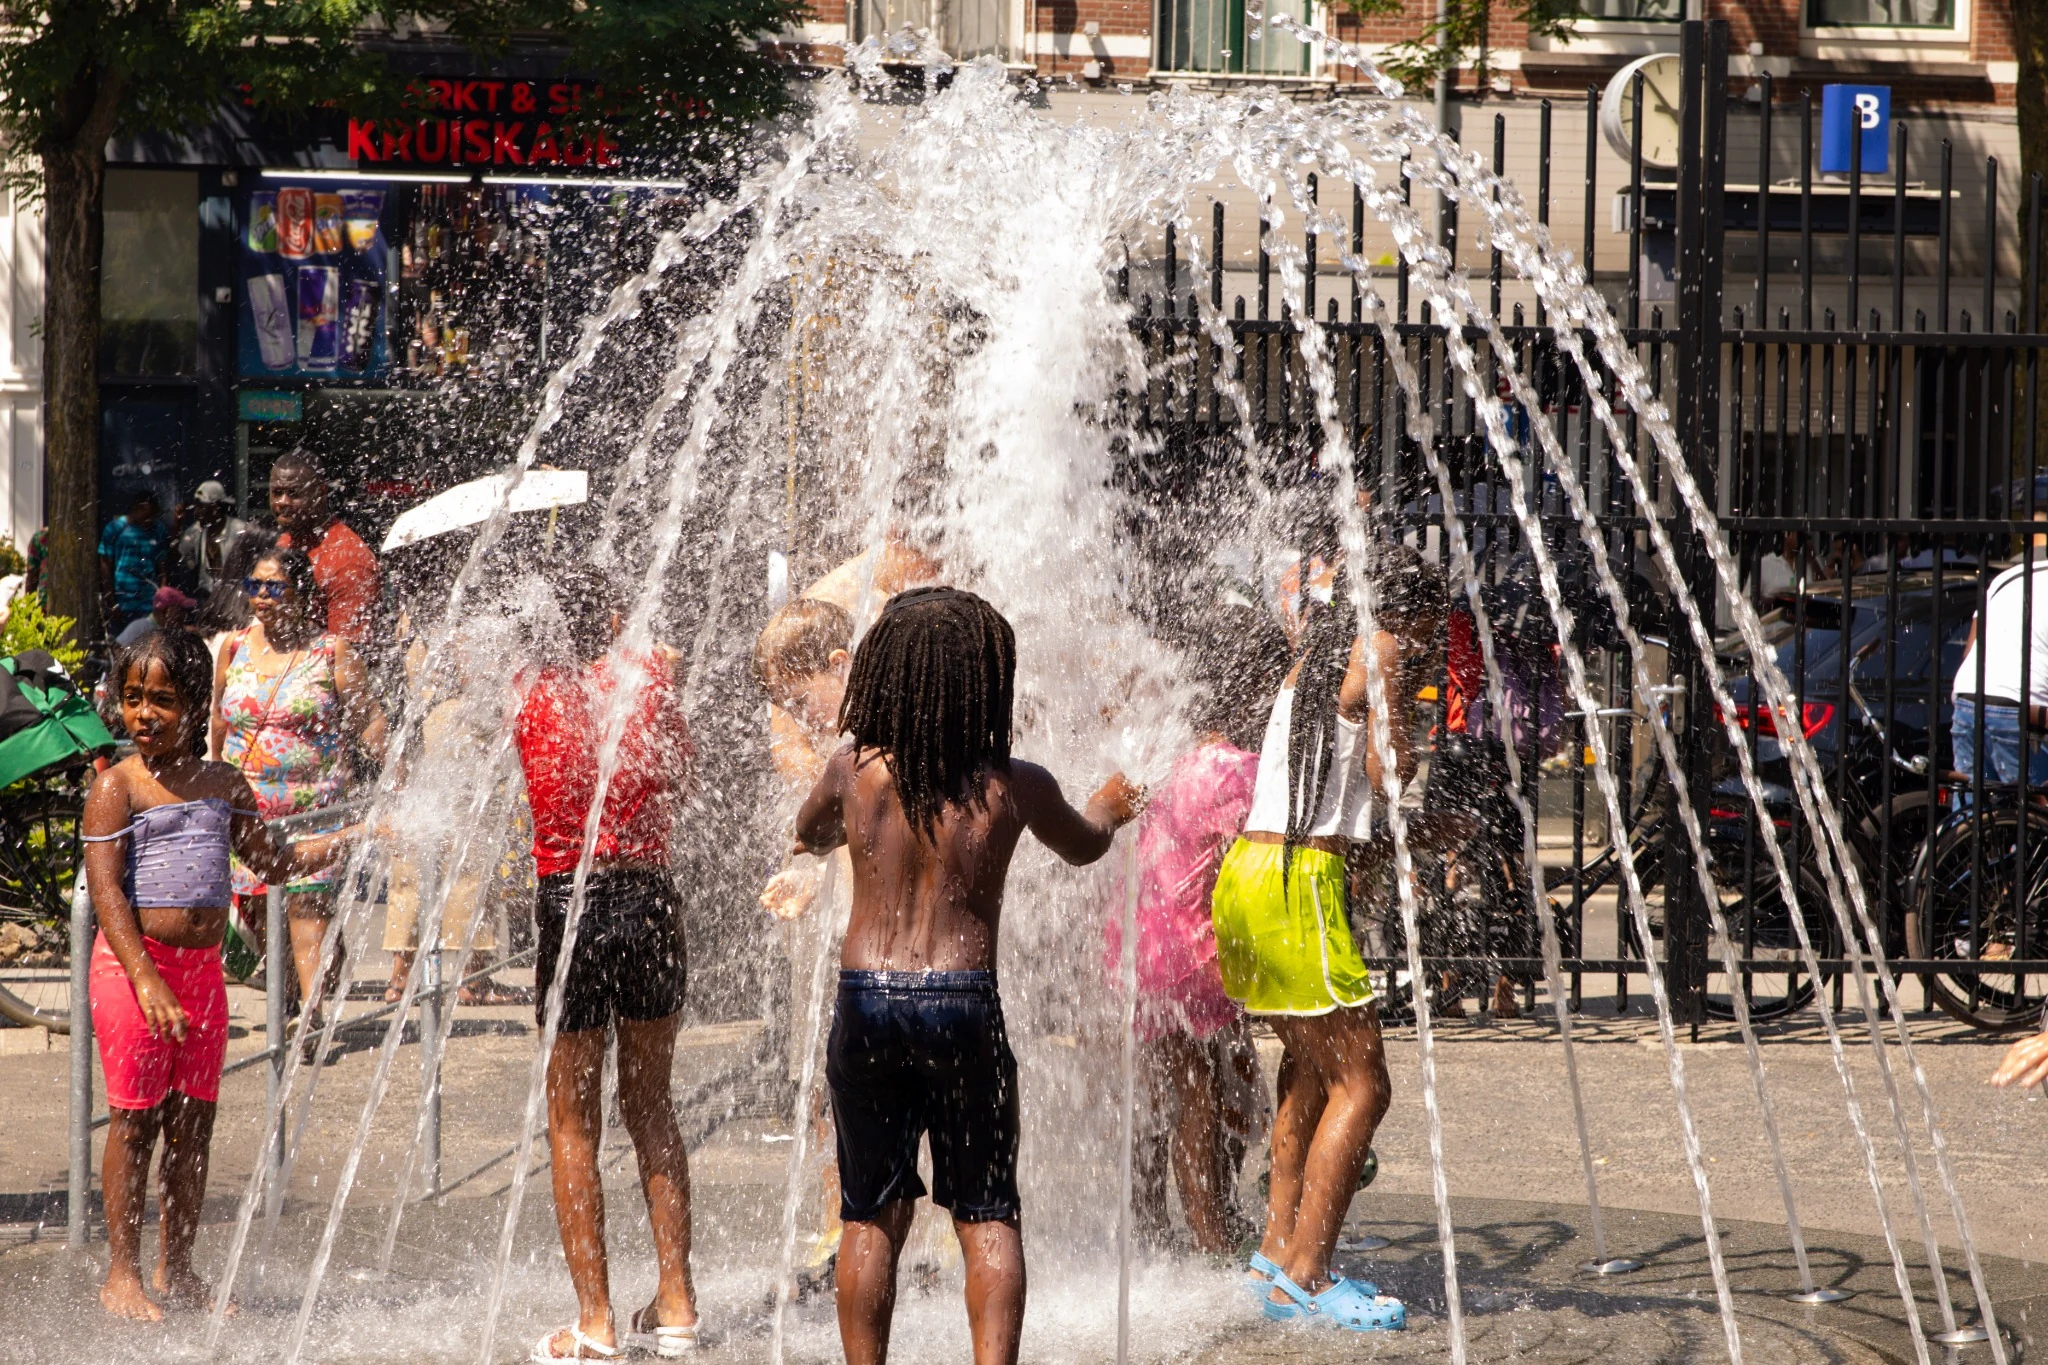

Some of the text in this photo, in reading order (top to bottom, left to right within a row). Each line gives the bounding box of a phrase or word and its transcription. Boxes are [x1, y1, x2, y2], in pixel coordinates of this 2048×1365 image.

[511, 82, 536, 113] &
[1855, 93, 1880, 129] B
[348, 117, 620, 167] KRUISKADE
